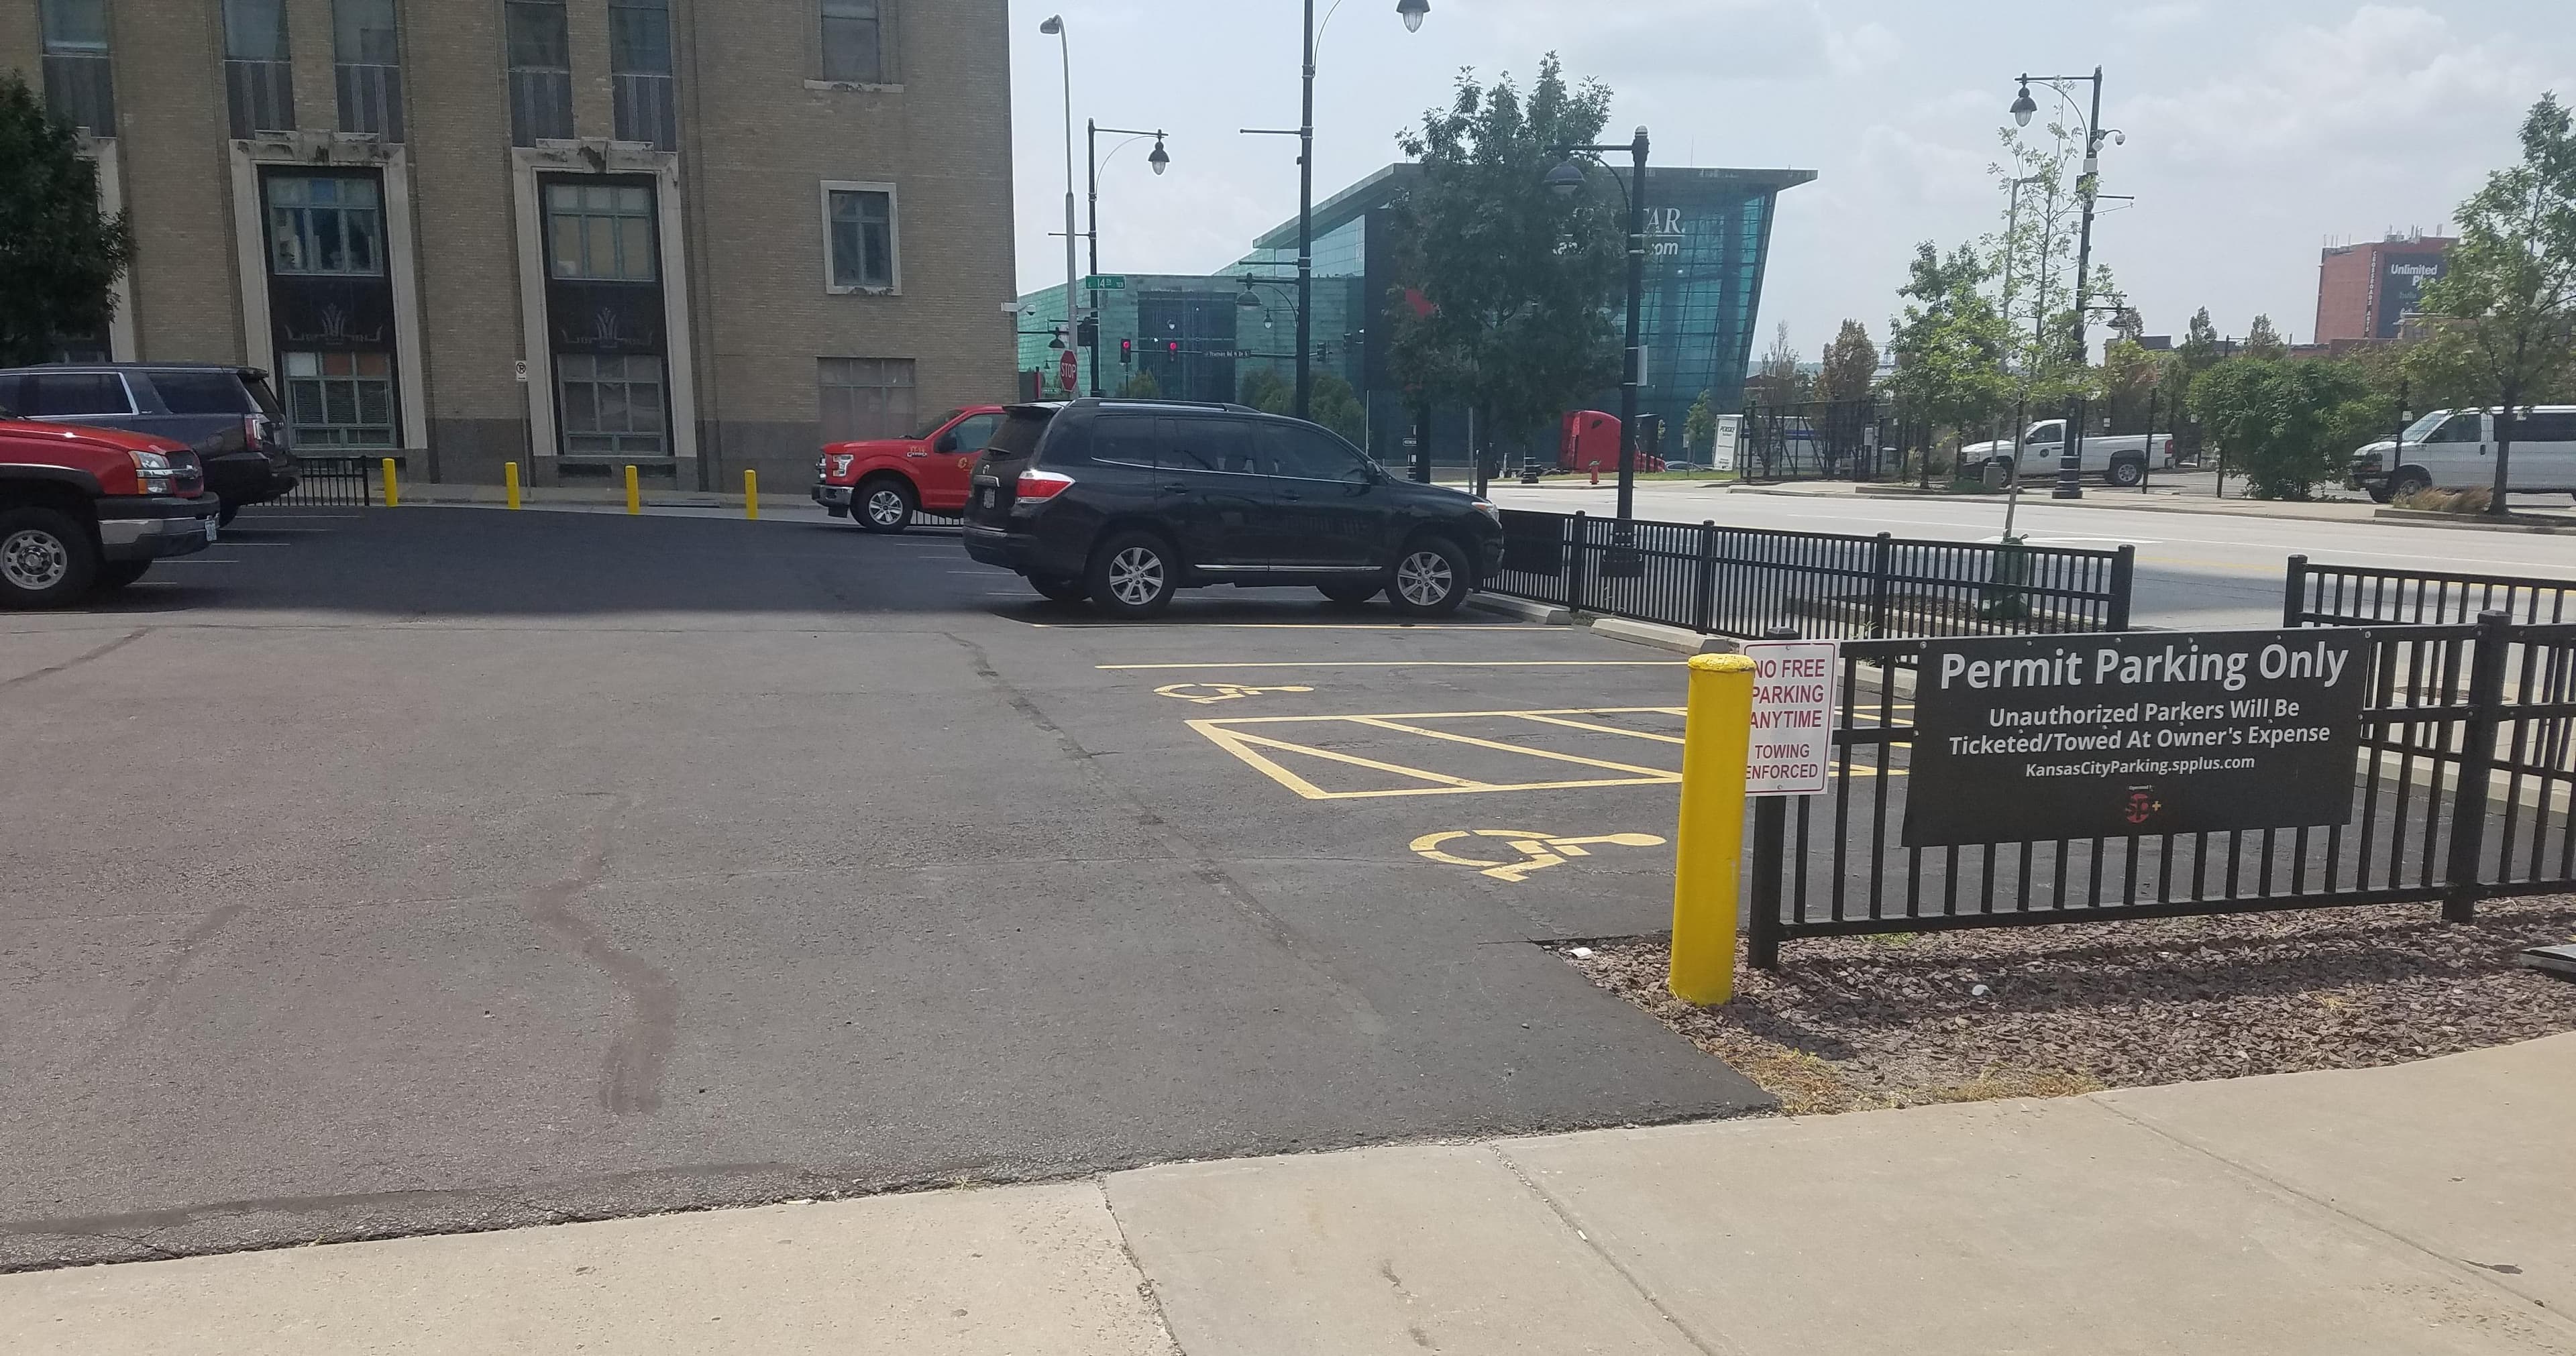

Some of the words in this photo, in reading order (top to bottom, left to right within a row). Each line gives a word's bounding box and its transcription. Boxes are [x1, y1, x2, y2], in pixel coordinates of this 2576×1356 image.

[2391, 264, 2438, 275] Unlimited
[1061, 362, 1076, 378] STOP
[1754, 659, 1777, 679] NO
[1782, 659, 1825, 678] FREE
[1941, 648, 2083, 689] Permit
[2095, 644, 2249, 691] Parking
[2259, 640, 2349, 687] Only
[1752, 684, 1824, 704] PARKING
[1750, 710, 1823, 729] ANYTIME
[1989, 702, 2139, 727] Unauthorized
[2145, 701, 2224, 722] Parkers
[2230, 698, 2269, 719] Will
[2274, 699, 2300, 718] Be
[1949, 730, 2123, 755] Ticketed/Towed
[2125, 730, 2152, 749] At
[2157, 727, 2243, 748] Owner's
[2248, 726, 2330, 749] Expense
[1754, 743, 1810, 759] TOWING
[1746, 763, 1818, 780] ENFORCED
[2025, 756, 2255, 778] KansasCityParking.spplus.com
